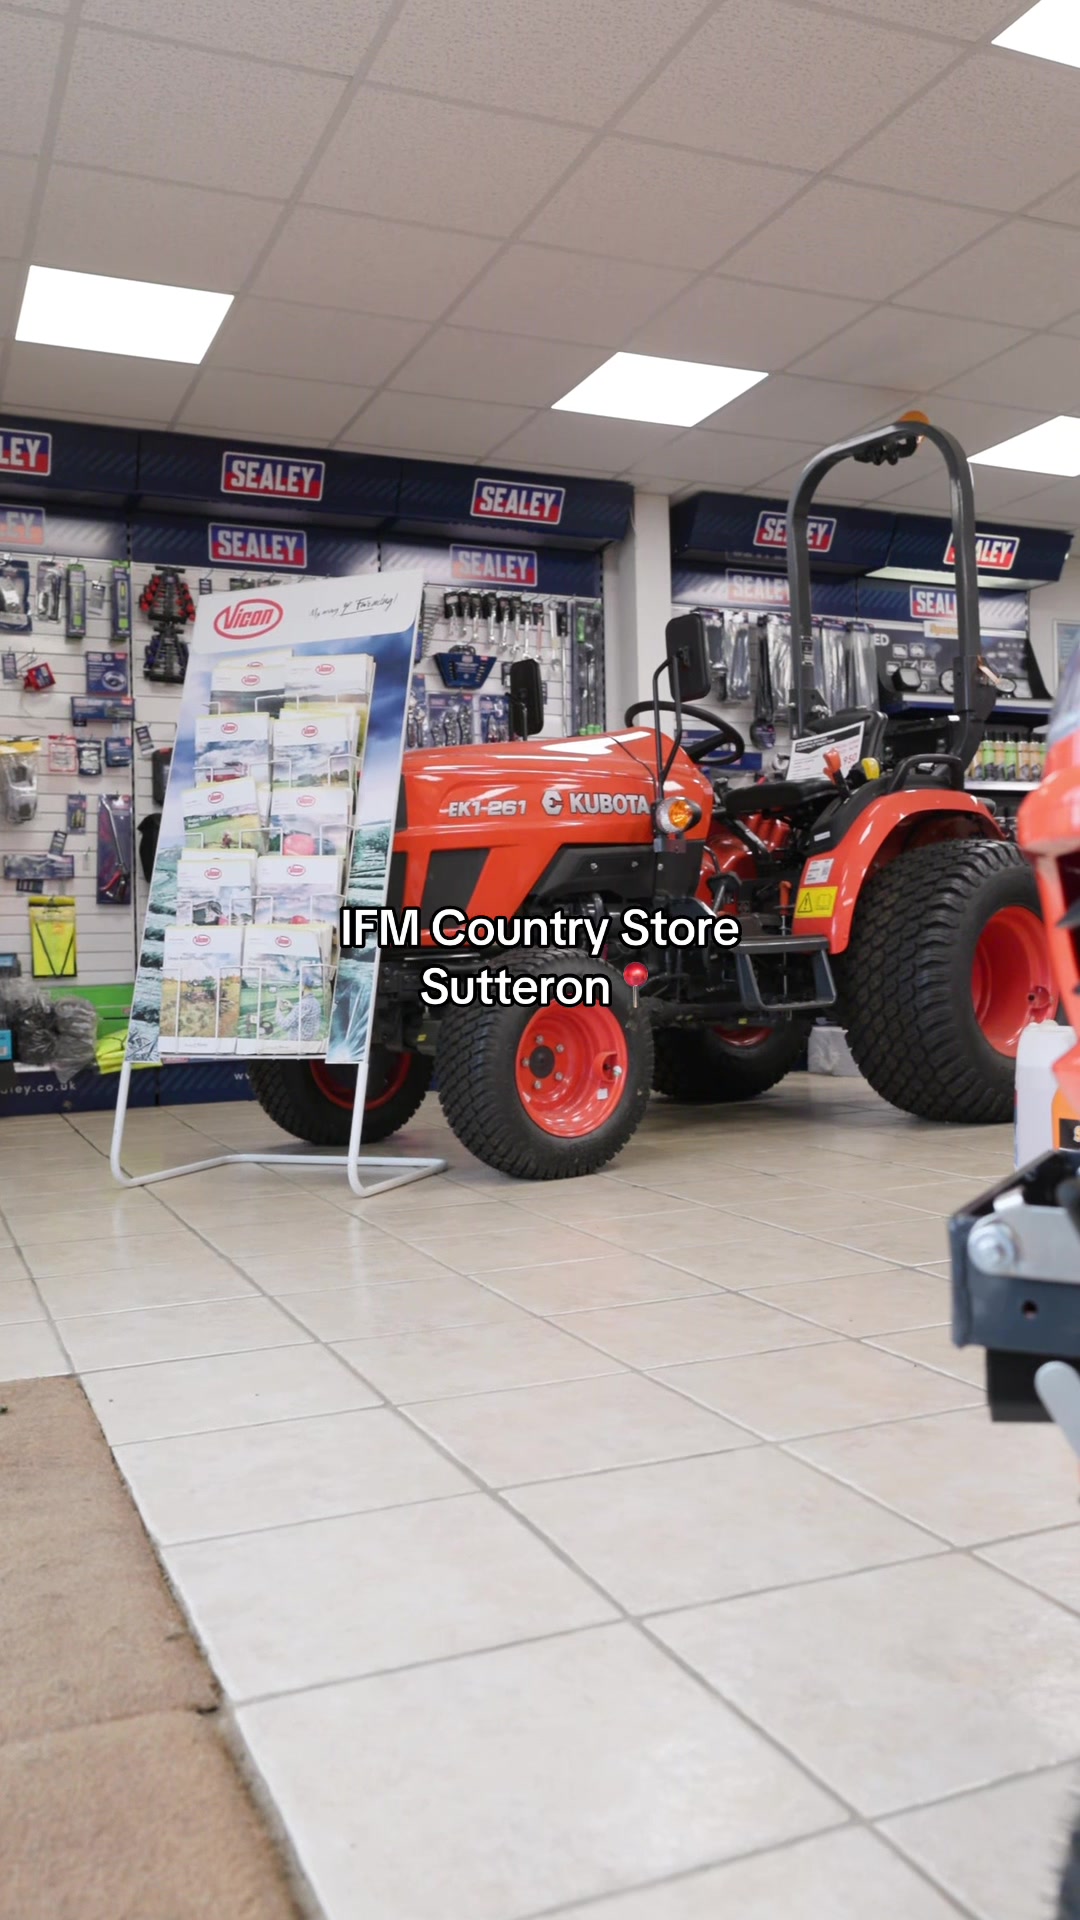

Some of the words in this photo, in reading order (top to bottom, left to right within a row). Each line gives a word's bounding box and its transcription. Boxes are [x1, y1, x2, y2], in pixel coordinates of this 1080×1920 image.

[0, 436, 41, 467] LEY
[231, 460, 315, 494] SEALEY
[479, 486, 556, 518] SEALEY
[0, 511, 35, 539] EY
[762, 518, 828, 546] SEEY
[218, 530, 297, 561] SEALEY
[457, 551, 529, 580] SEALEY
[220, 601, 276, 632] Vicon
[916, 591, 957, 614] SEAL
[874, 634, 890, 646] ED
[449, 800, 527, 817] EK1-261
[569, 793, 650, 815] KUBOTA
